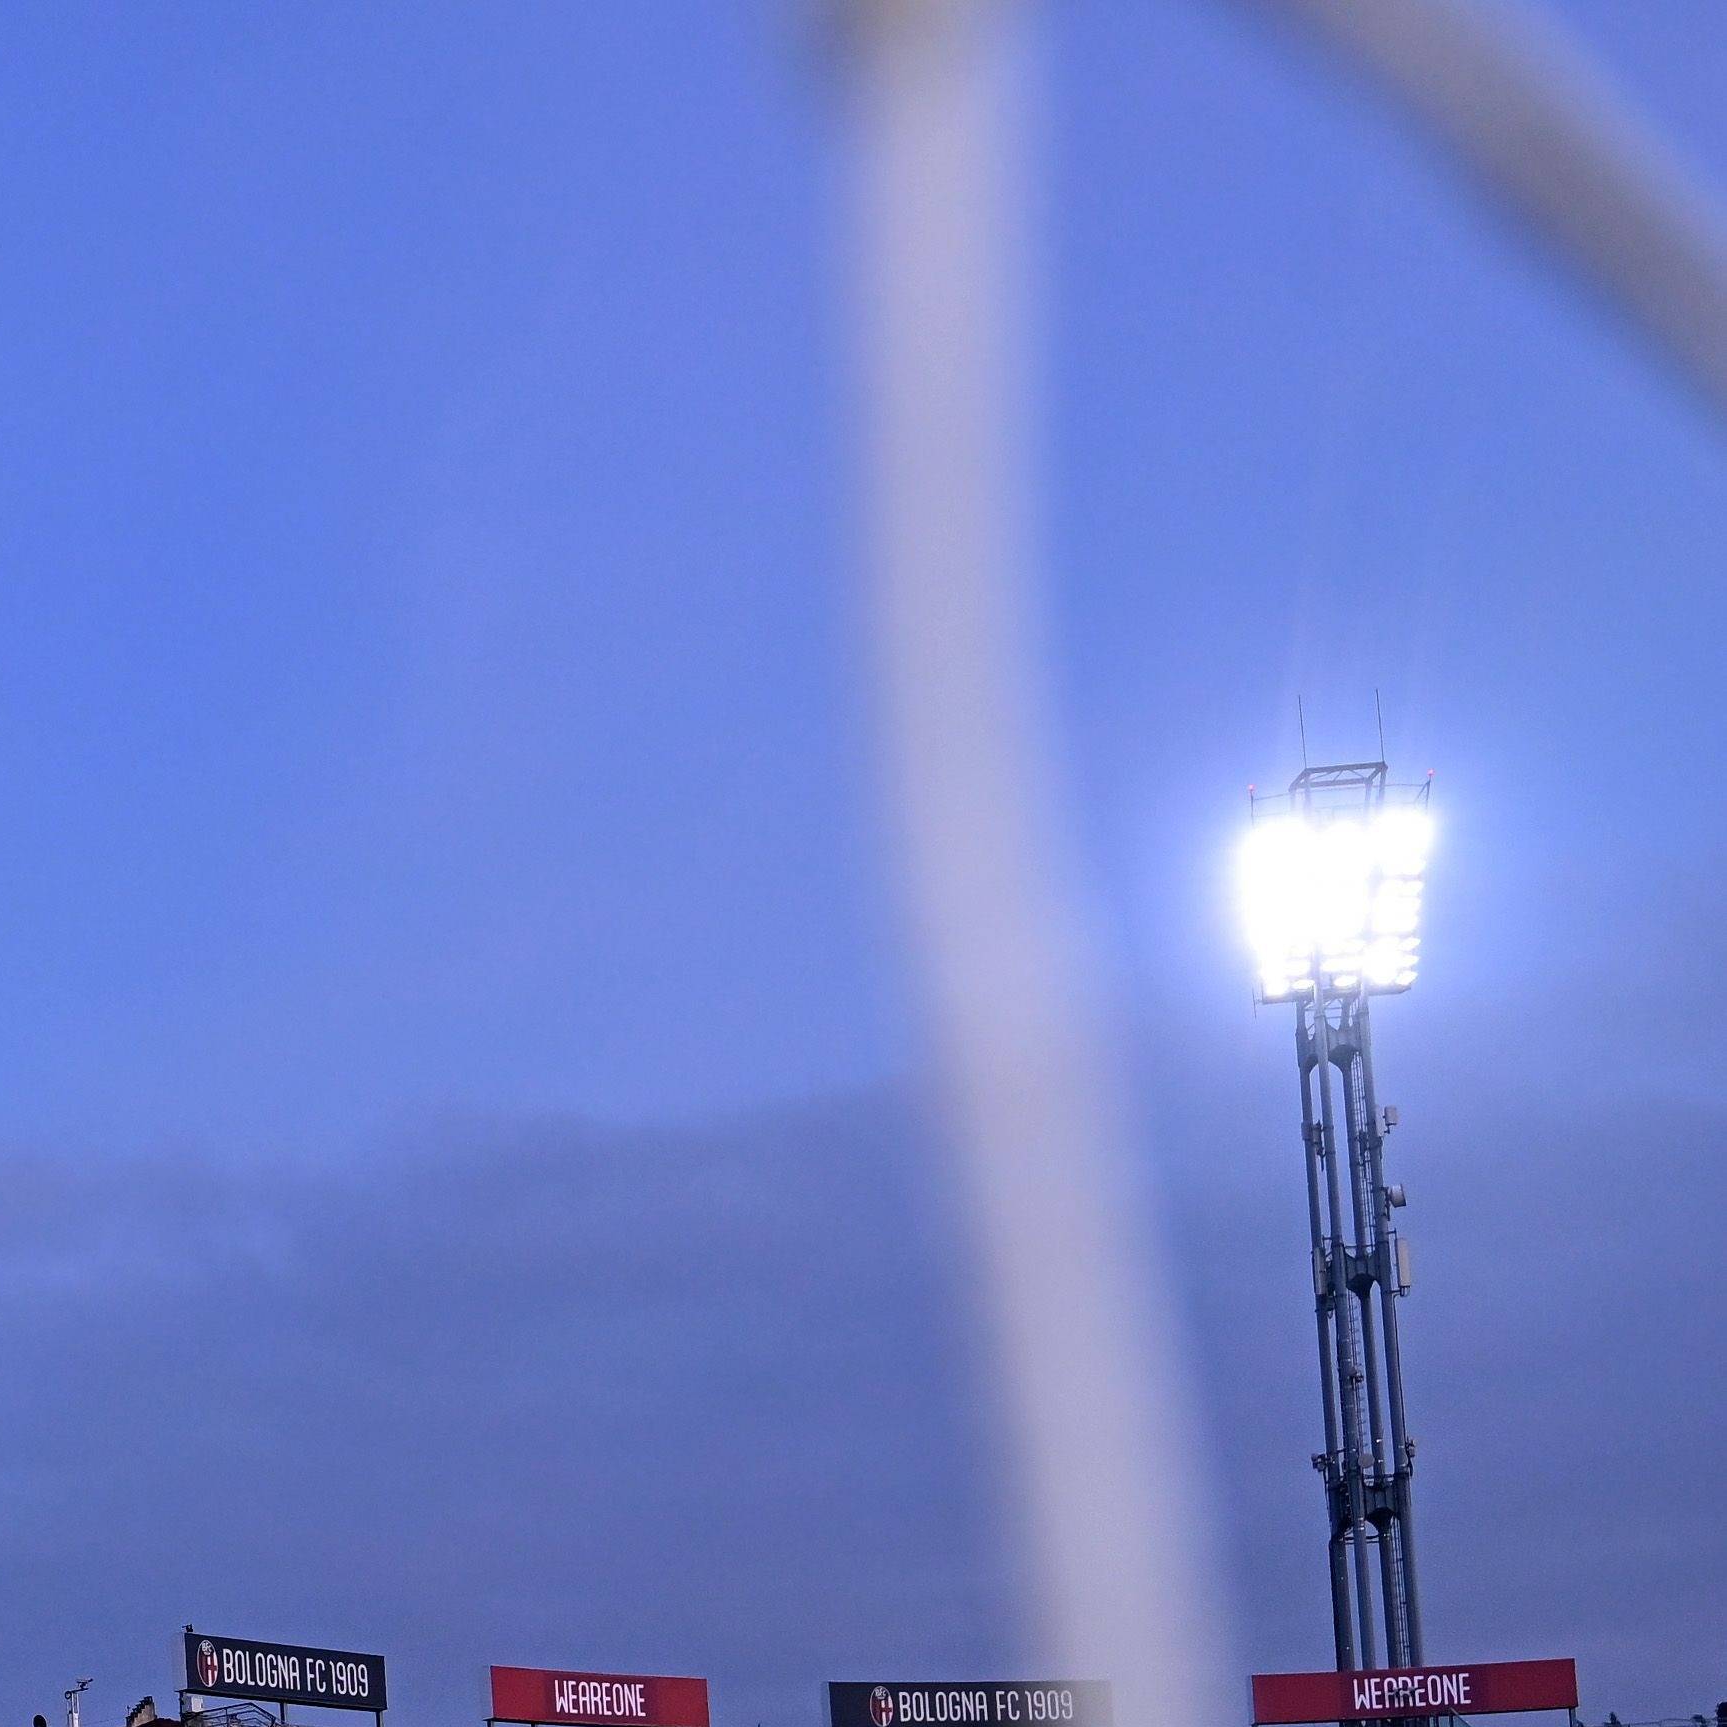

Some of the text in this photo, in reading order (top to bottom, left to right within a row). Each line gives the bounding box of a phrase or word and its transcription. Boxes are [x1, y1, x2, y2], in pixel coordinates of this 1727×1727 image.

[223, 1648, 369, 1697] BOLOGNA FC 1909
[554, 1679, 646, 1717] WEAREONE
[898, 1690, 1073, 1722] BOLOGNA FC 1909
[1353, 1673, 1472, 1710] WEAREONE
